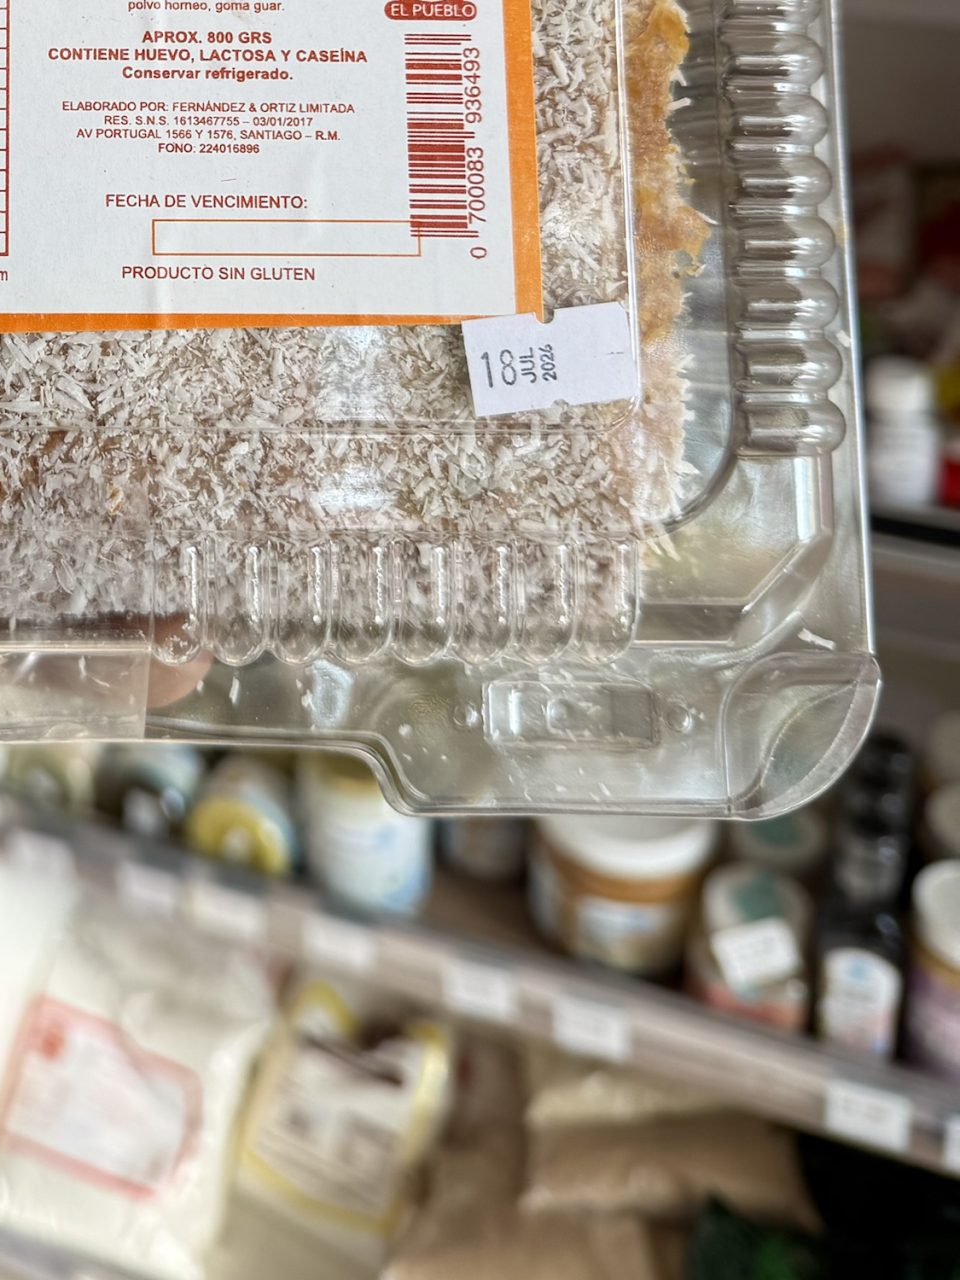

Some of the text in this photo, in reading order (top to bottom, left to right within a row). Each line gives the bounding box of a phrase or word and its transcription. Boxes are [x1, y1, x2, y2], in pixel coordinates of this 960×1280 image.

[128, 0, 284, 13] polvo horneo, goma guar.
[390, 3, 475, 17] EL PUEBLO
[142, 31, 272, 44] APROX. 800 GRS
[48, 48, 367, 63] CONTIENE HUEVO, LACTOSA Y CASEÍNA
[122, 66, 293, 82] Conservar refrigerado.
[463, 47, 482, 123] 936493
[62, 100, 355, 113] ELABORADO POR: FERNÁNDEZ & ORTIZ LIMITADA
[104, 115, 131, 125] RES.
[135, 116, 169, 125] S.N.S.
[174, 116, 240, 126] 1613467755
[253, 117, 313, 127] 03/01/2017
[76, 128, 93, 138] AV
[96, 129, 161, 139] PORTUGAL
[166, 129, 192, 139] 1566
[195, 130, 203, 139] Y
[207, 130, 236, 140] 1576,
[240, 130, 302, 140] SANTIAGO
[315, 130, 340, 140] R.M.
[158, 142, 260, 153] FONO: 224016896
[466, 147, 487, 225] 700083
[106, 194, 307, 209] FECHA DE VENCIMIENTO:
[122, 265, 315, 280] PRODUCTO SIN GLUTEN
[480, 349, 517, 388] 18
[519, 347, 537, 383] JUL
[539, 344, 557, 381] 2026
